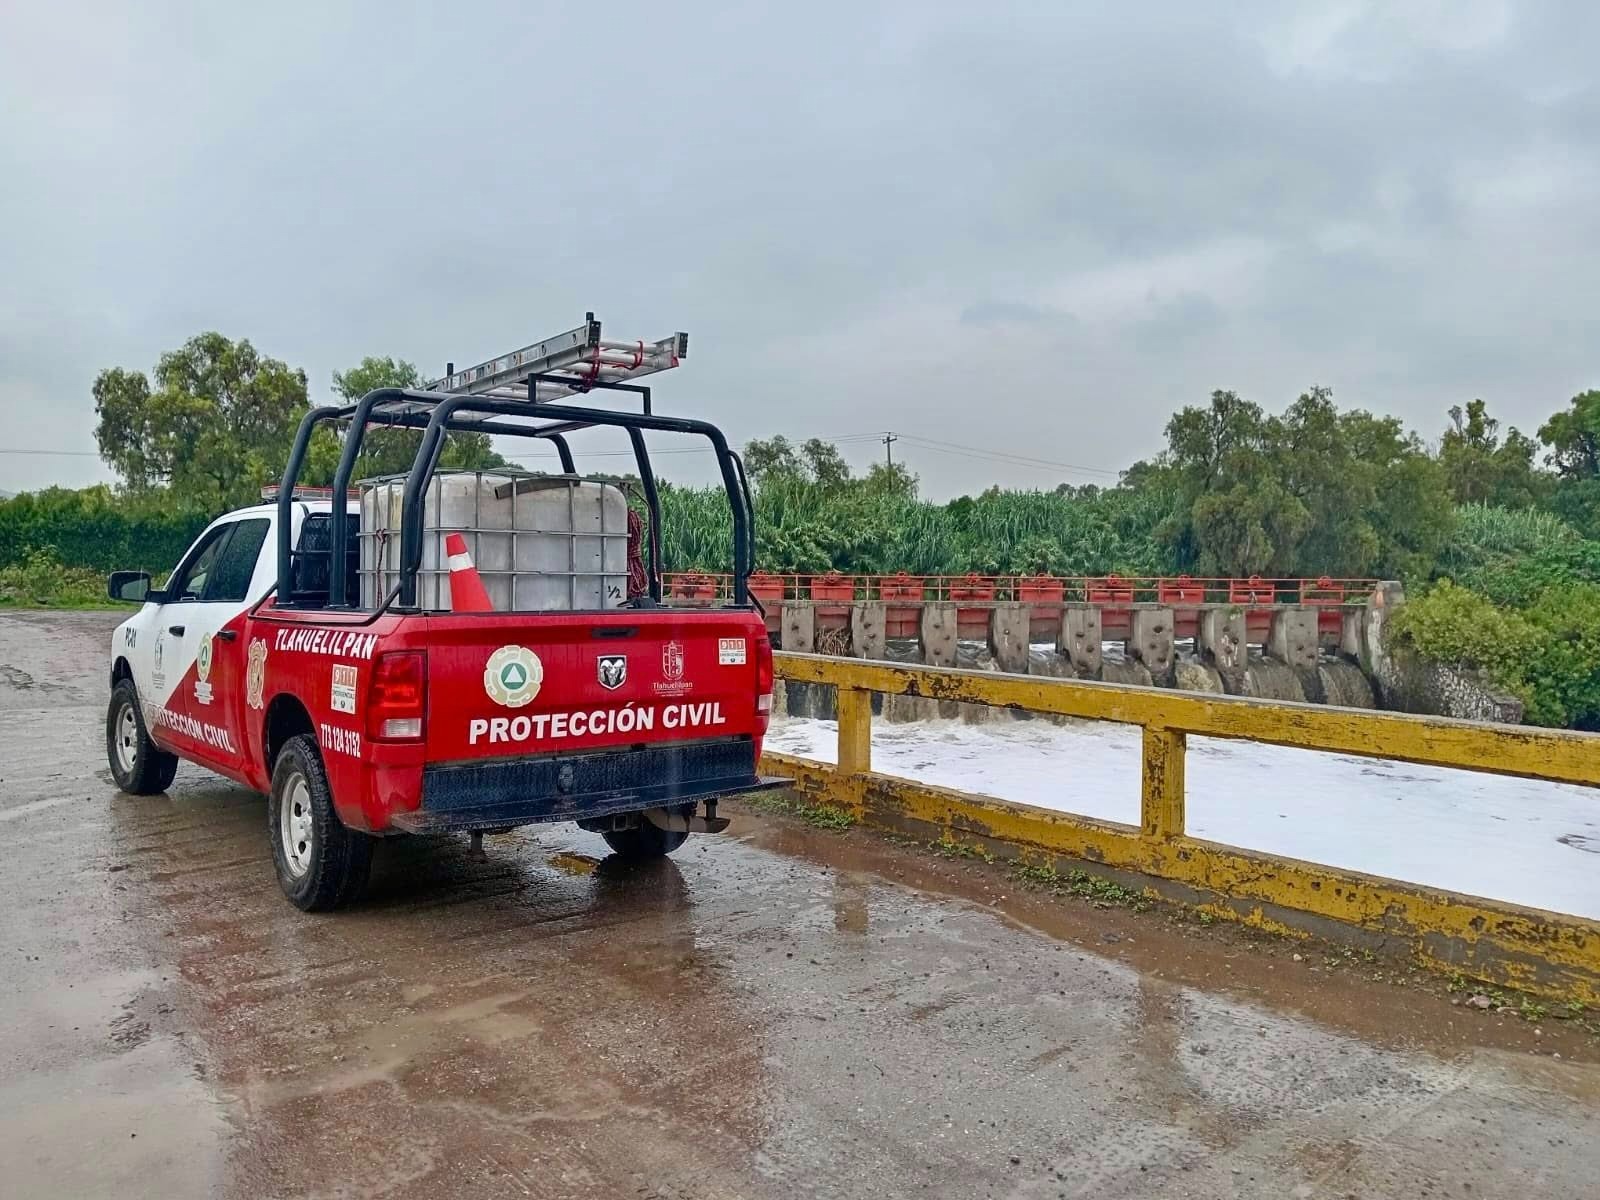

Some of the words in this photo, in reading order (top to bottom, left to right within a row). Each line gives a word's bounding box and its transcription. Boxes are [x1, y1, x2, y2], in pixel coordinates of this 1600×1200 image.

[607, 585, 622, 599] 1/2
[274, 628, 378, 660] TLAHUELILPAN
[720, 640, 744, 650] 911
[334, 668, 355, 685] 911
[147, 703, 206, 742] OTECCIÓN
[203, 723, 236, 753] CIVIL
[469, 701, 655, 745] PROTECCIÓN
[662, 702, 726, 729] CIVIL
[320, 723, 333, 750] 773
[332, 726, 345, 753] 124
[344, 729, 361, 759] 3152
